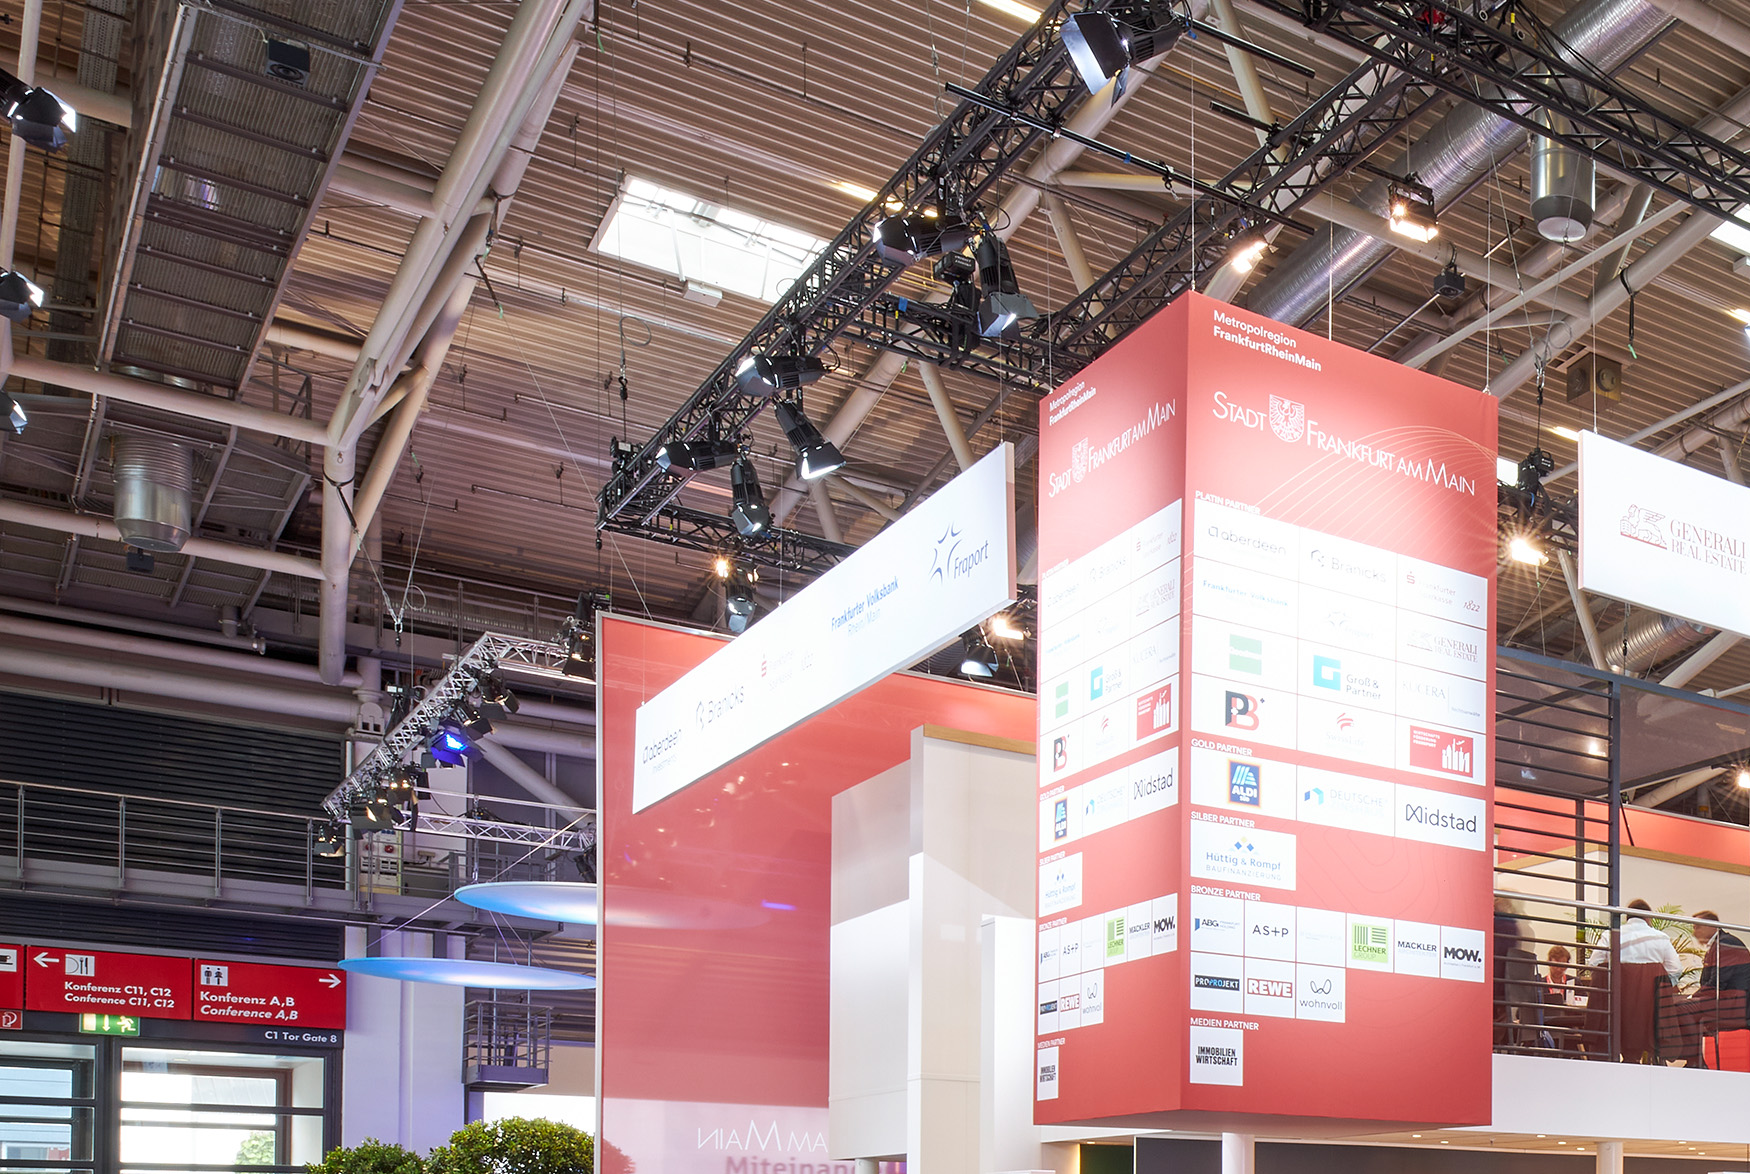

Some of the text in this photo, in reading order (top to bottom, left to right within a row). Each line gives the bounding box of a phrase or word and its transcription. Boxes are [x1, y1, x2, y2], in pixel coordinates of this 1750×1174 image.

[1214, 310, 1297, 348] Metropolregion
[1213, 326, 1322, 371] FrankfurtRheinMain
[1307, 420, 1395, 471] FRANKFURT
[1195, 490, 1224, 505] PLATIN
[1221, 530, 1287, 556] aberdeen
[1670, 518, 1746, 559] GENERALI
[953, 539, 989, 579] Fraport
[1672, 538, 1746, 575] REAL ESTATE
[1331, 557, 1387, 583] Branicks
[831, 575, 900, 632] Frankfurter Volksbank
[1433, 635, 1478, 655] GENERALI
[1346, 684, 1381, 700] Partner
[1191, 738, 1253, 757] GOLD PARTNER
[1231, 784, 1257, 800] ALDI
[1191, 811, 1255, 828] SILBER PARTNER
[1206, 852, 1238, 867] Hüttig
[1250, 857, 1281, 871] Rompf
[1191, 885, 1261, 901] BRONZE PARTNER
[1252, 924, 1289, 938] AS+P
[1353, 945, 1387, 955] LECHNER
[1444, 946, 1482, 963] MOW.
[64, 981, 171, 997] Konferenz C11, C12
[1248, 979, 1292, 997] REWE
[64, 993, 174, 1008] Conference C11, C12
[200, 991, 295, 1009] Konferenz A,B
[1300, 999, 1342, 1011] wohnvoll
[200, 1004, 298, 1020] Conference A,B
[1190, 1018, 1259, 1030] MEDIEN PARTNER
[264, 1031, 337, 1043] C1 Tor Gate 8
[1198, 1046, 1236, 1057] IMMOBILIEN
[1196, 1054, 1238, 1067] WIRTSCHAFT
